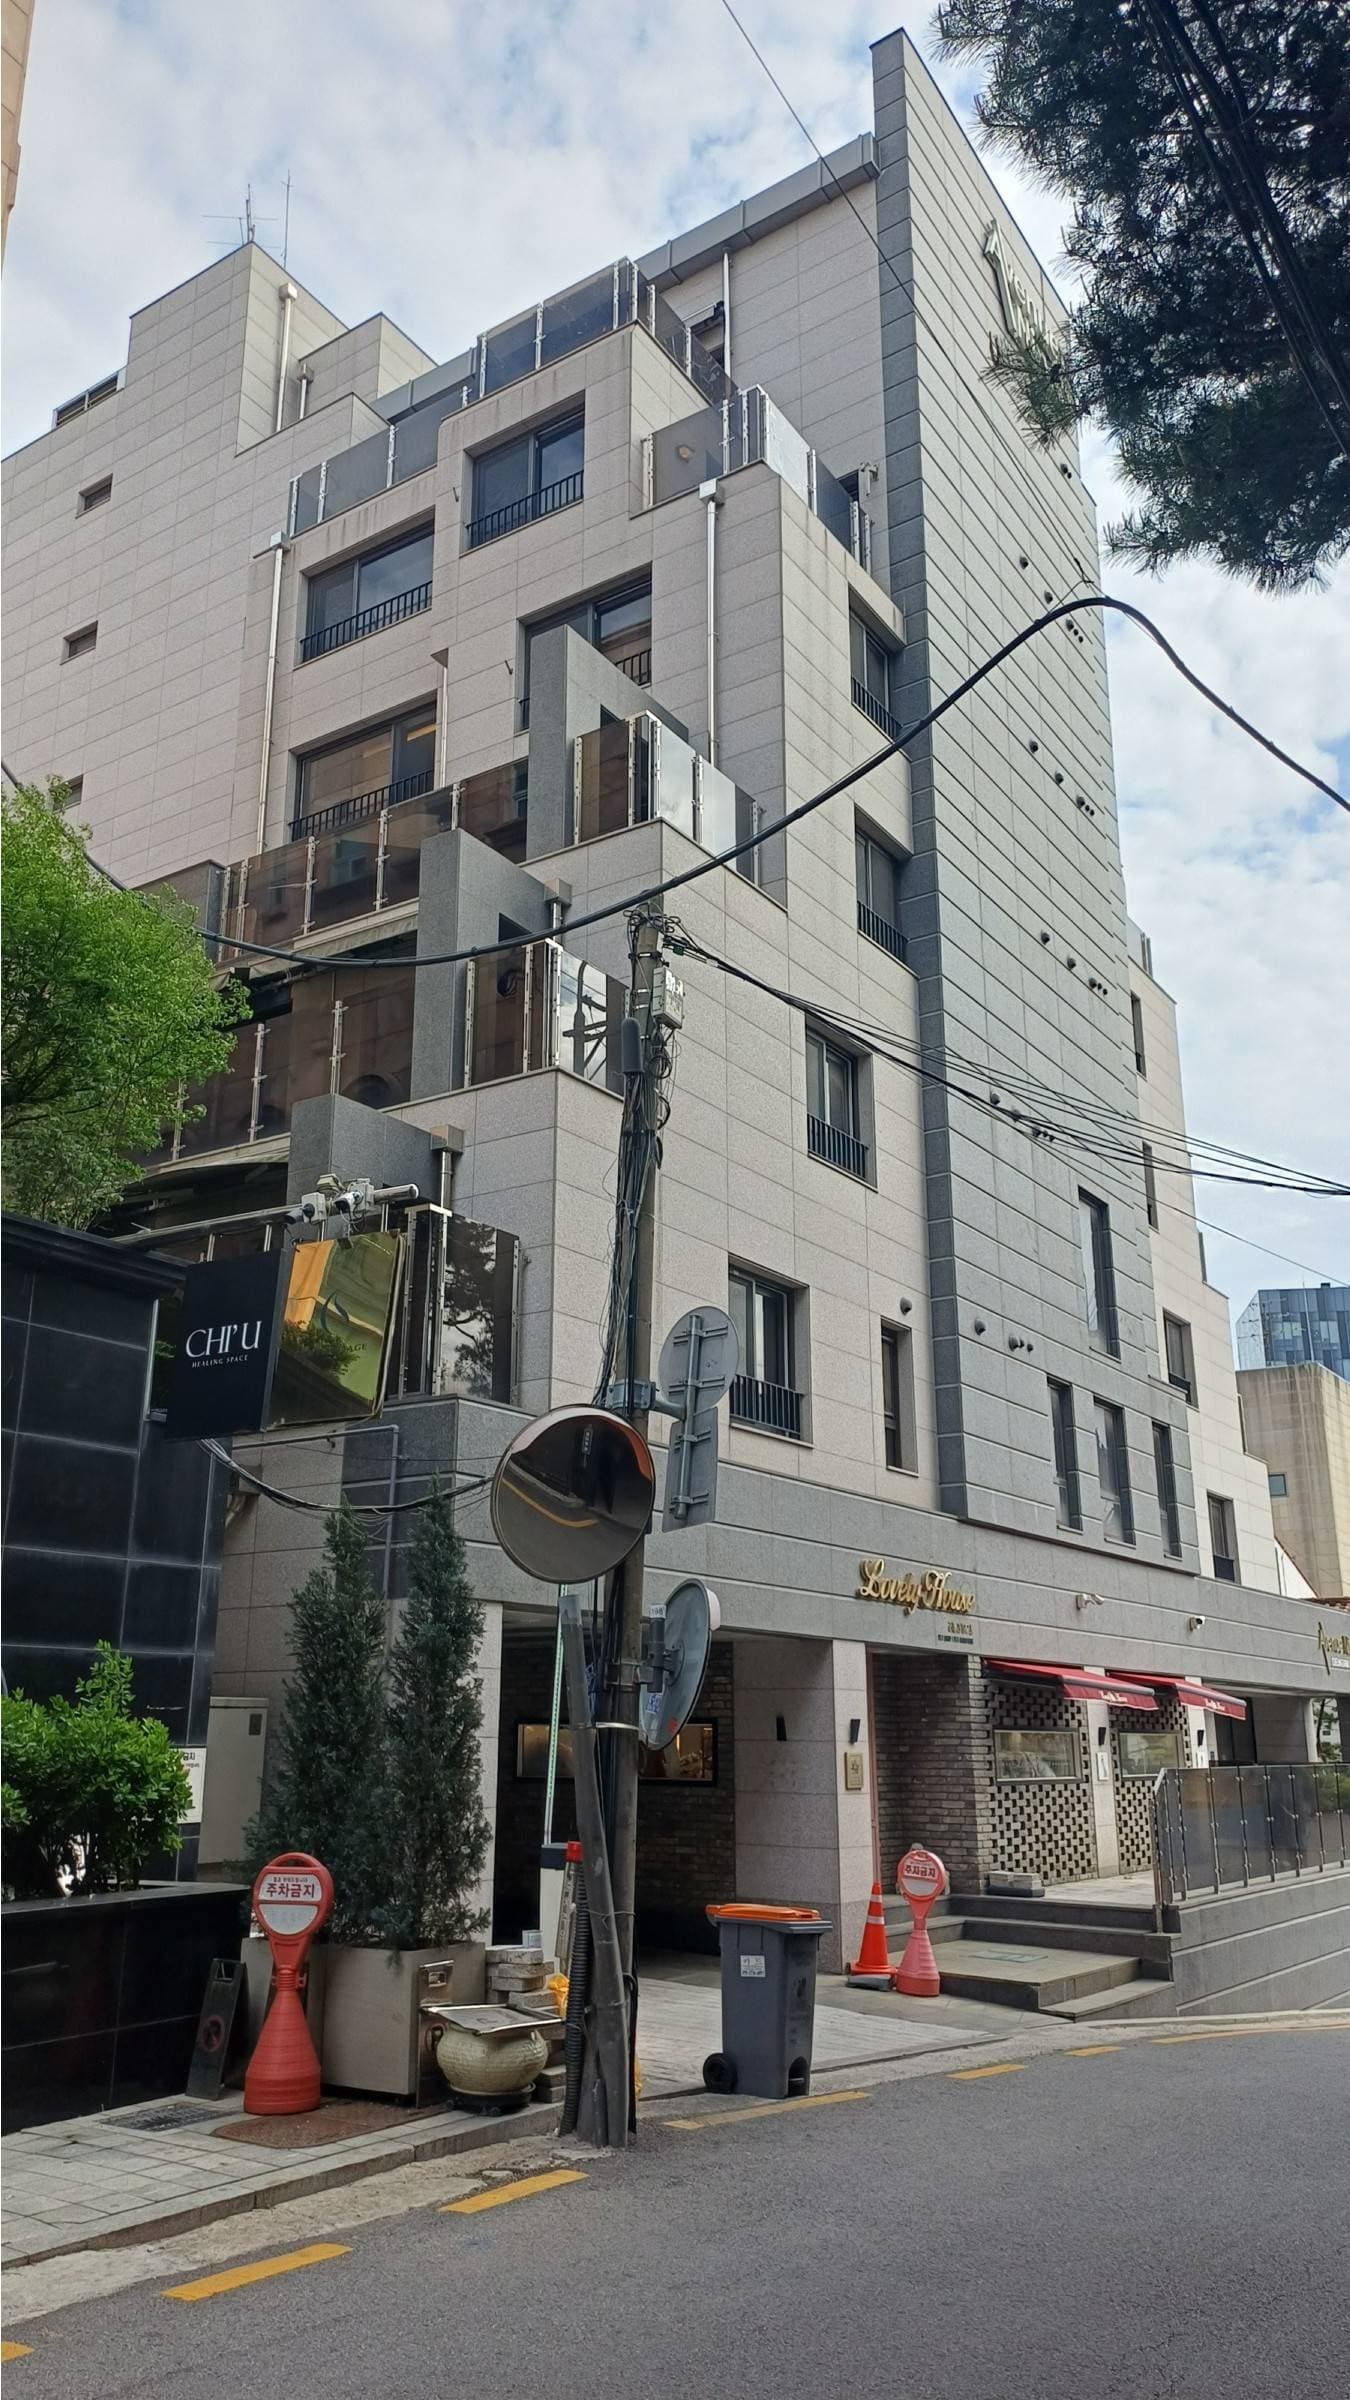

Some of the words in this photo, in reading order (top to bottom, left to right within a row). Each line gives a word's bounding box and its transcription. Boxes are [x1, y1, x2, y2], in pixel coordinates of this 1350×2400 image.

[192, 1358, 223, 1368] HEALING
[226, 1354, 248, 1364] SPACE
[857, 1559, 921, 1616] Lovely
[921, 1570, 976, 1614] House
[905, 1865, 936, 1877] 주차금지
[266, 1883, 315, 1899] 주차금지
